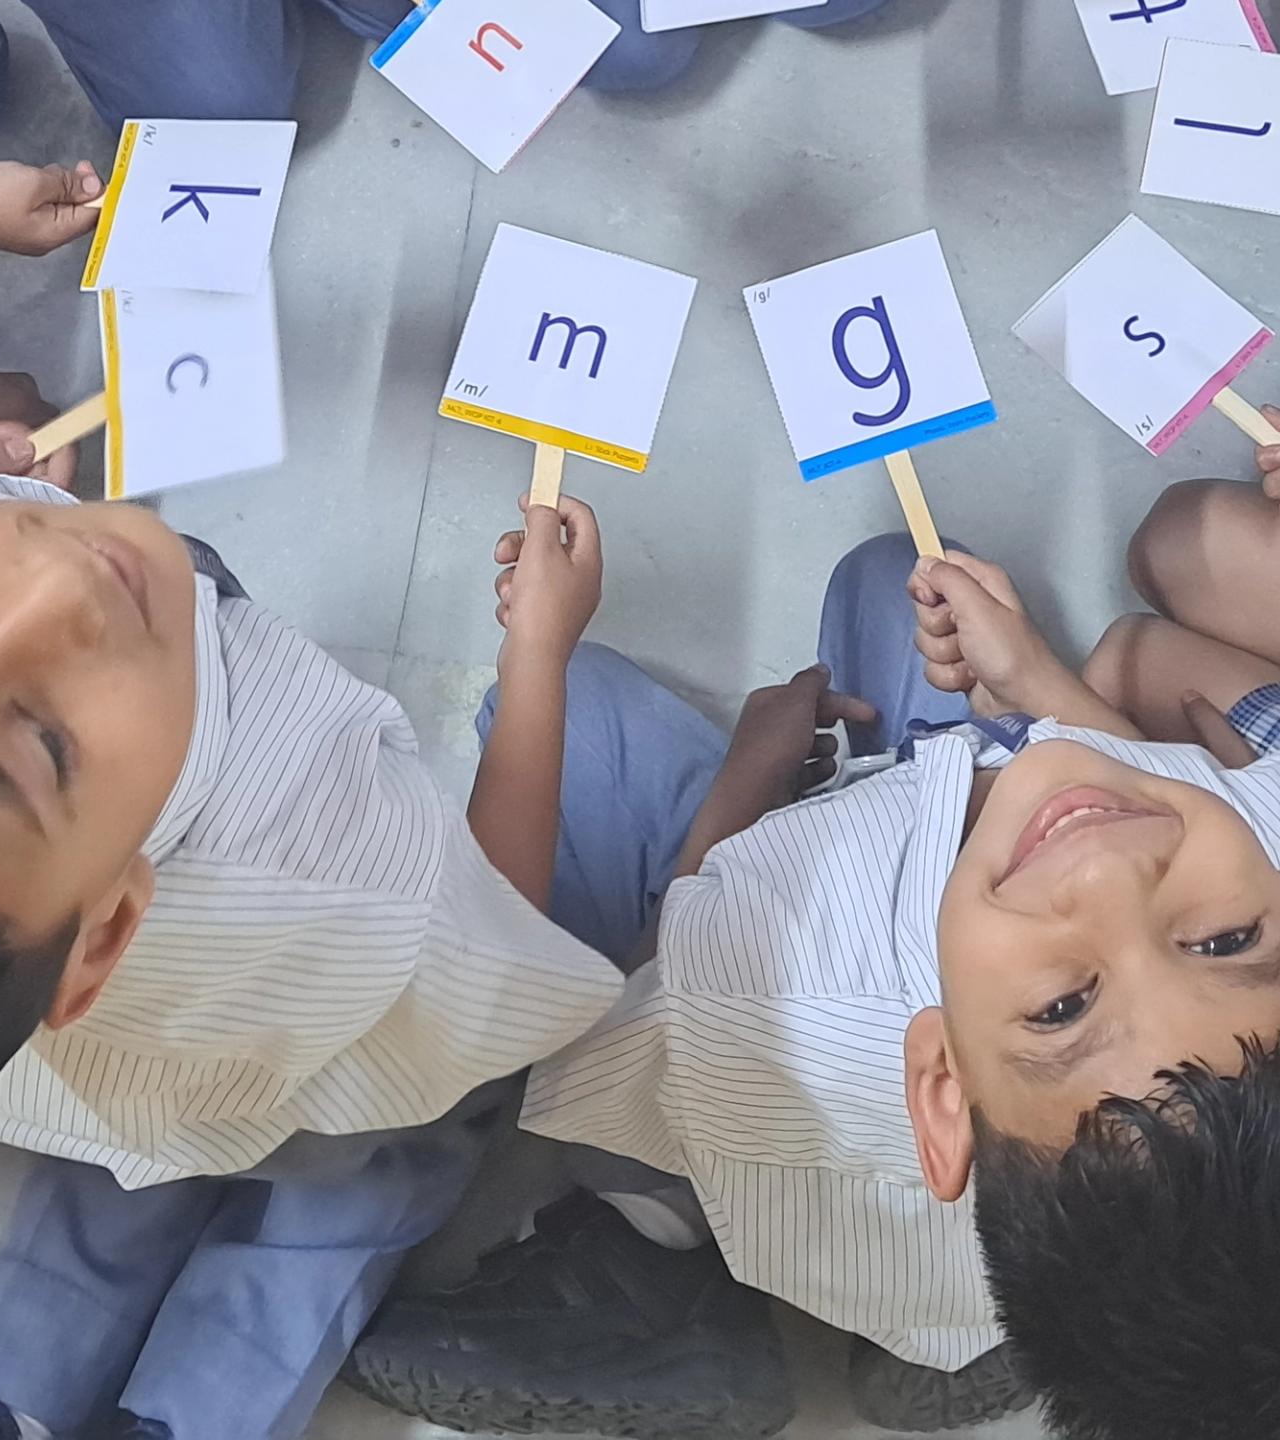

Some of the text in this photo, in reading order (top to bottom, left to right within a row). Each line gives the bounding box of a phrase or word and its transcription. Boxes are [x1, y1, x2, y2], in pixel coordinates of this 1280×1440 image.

[161, 183, 262, 224] k
[528, 311, 607, 379] m
[1122, 314, 1166, 358] s
[165, 352, 209, 394] c
[832, 295, 911, 427] g
[454, 378, 489, 398] /m/
